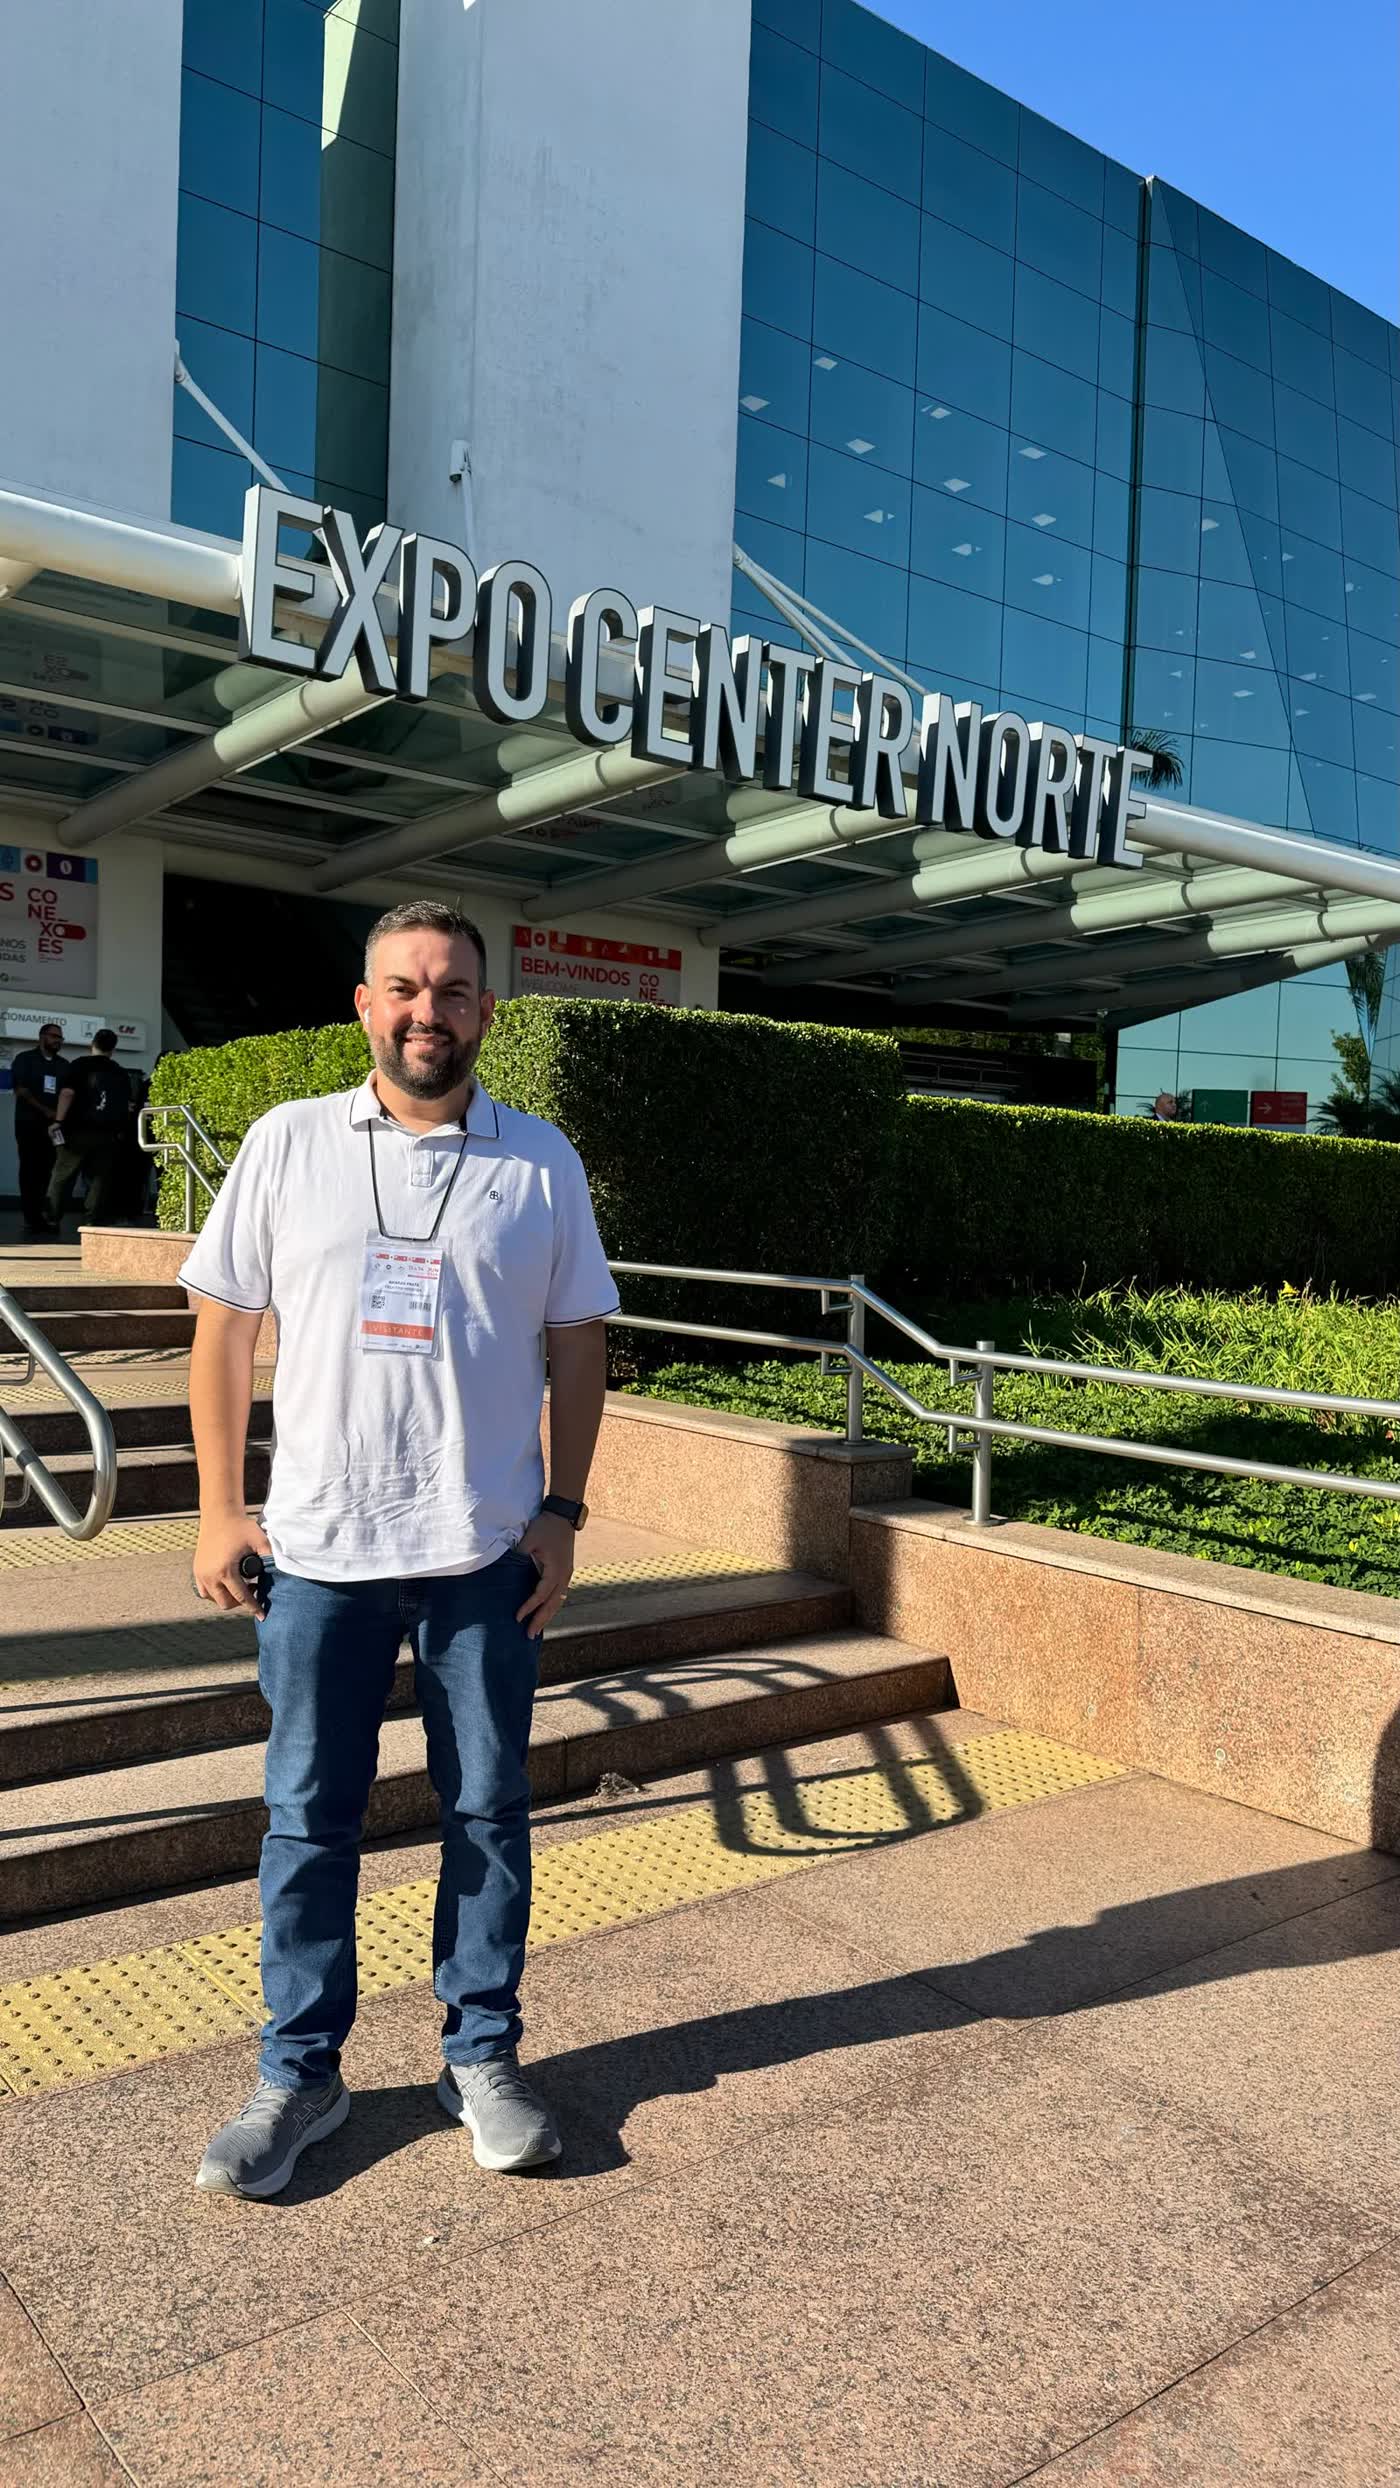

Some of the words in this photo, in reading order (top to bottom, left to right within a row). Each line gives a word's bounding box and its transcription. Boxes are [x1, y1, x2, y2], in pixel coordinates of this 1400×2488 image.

[240, 484, 553, 724] EXPO
[565, 587, 913, 818] CENTER
[916, 692, 1154, 870] NORTE
[27, 887, 58, 905] CO
[38, 937, 63, 954] ES
[520, 957, 631, 986] BEM-VINDOS
[639, 973, 660, 987] CO
[0, 1010, 67, 1026] CIONAMENTO
[372, 1324, 424, 1337] VISITANTE
